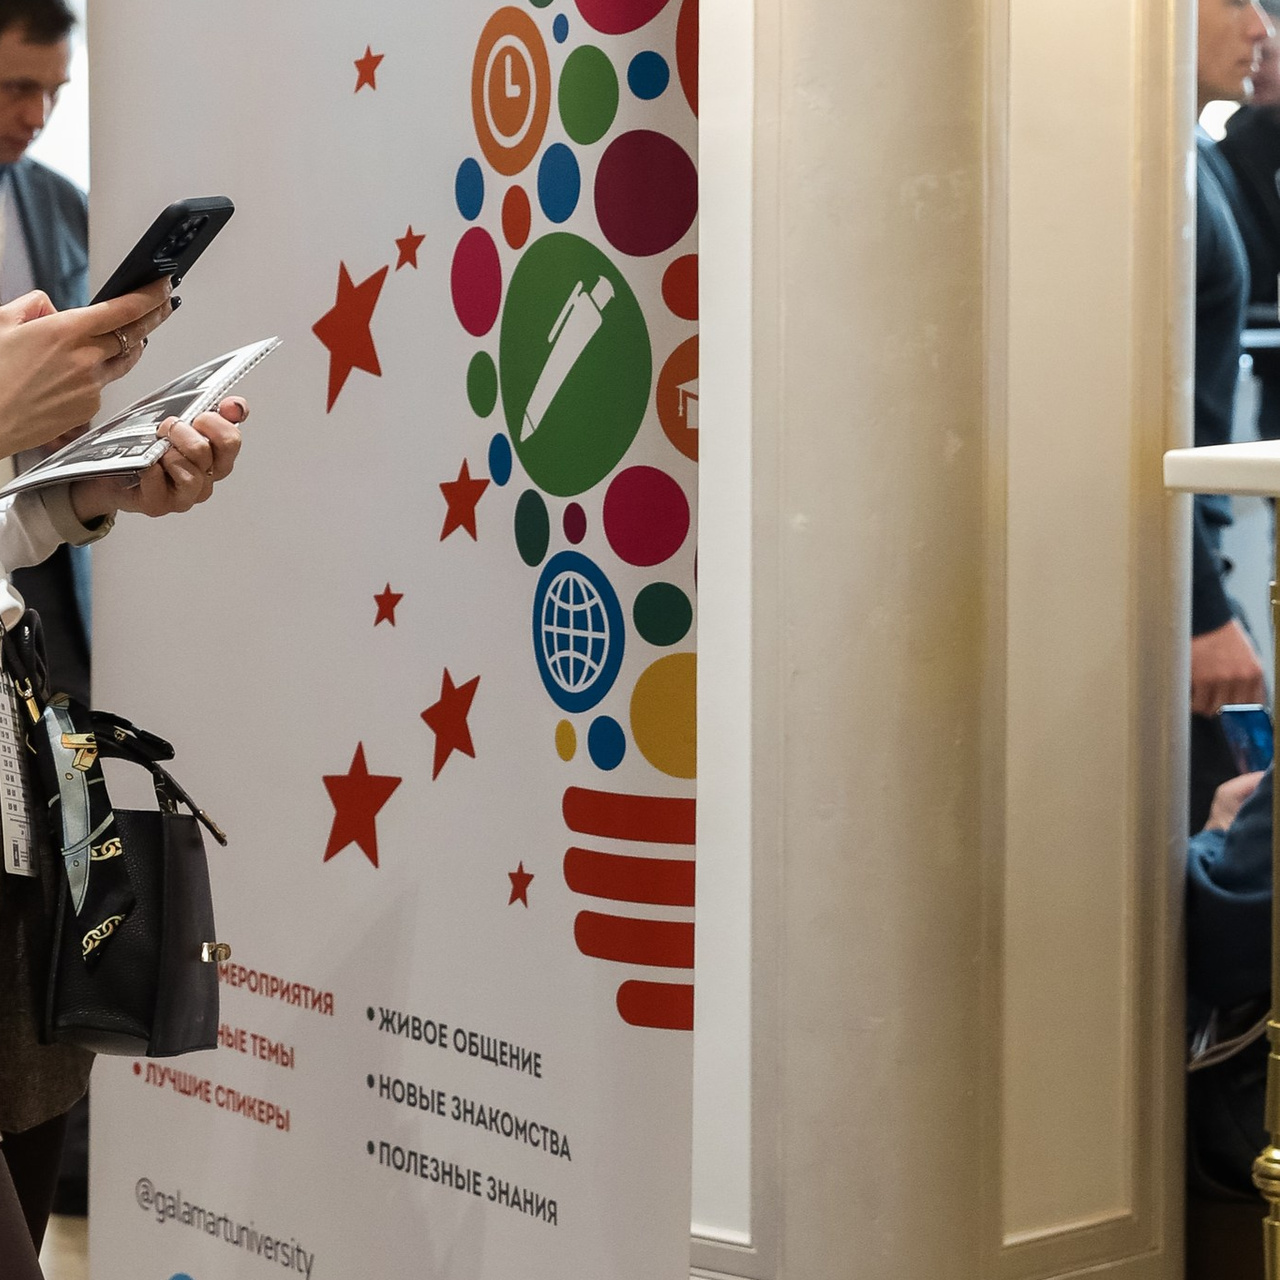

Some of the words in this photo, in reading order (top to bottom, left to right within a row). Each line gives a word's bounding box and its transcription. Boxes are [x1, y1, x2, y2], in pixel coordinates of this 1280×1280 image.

[218, 962, 334, 1016] МЕРОПРИЯТИЯ
[250, 1033, 295, 1069] ТЕМЫ
[378, 1007, 448, 1049] ЖИВОЕ
[453, 1028, 542, 1079] ОБЩЕНИЕ
[144, 1062, 212, 1103] ЛУЧШИЕ
[215, 1085, 290, 1132] СПИКЕРЫ
[378, 1074, 447, 1116] НОВЫЕ
[451, 1096, 572, 1162] ЗНАКОМСТВА
[378, 1141, 482, 1197] ПОЛЕЗНЫЕ
[486, 1176, 558, 1226] ЗНАНИЯ
